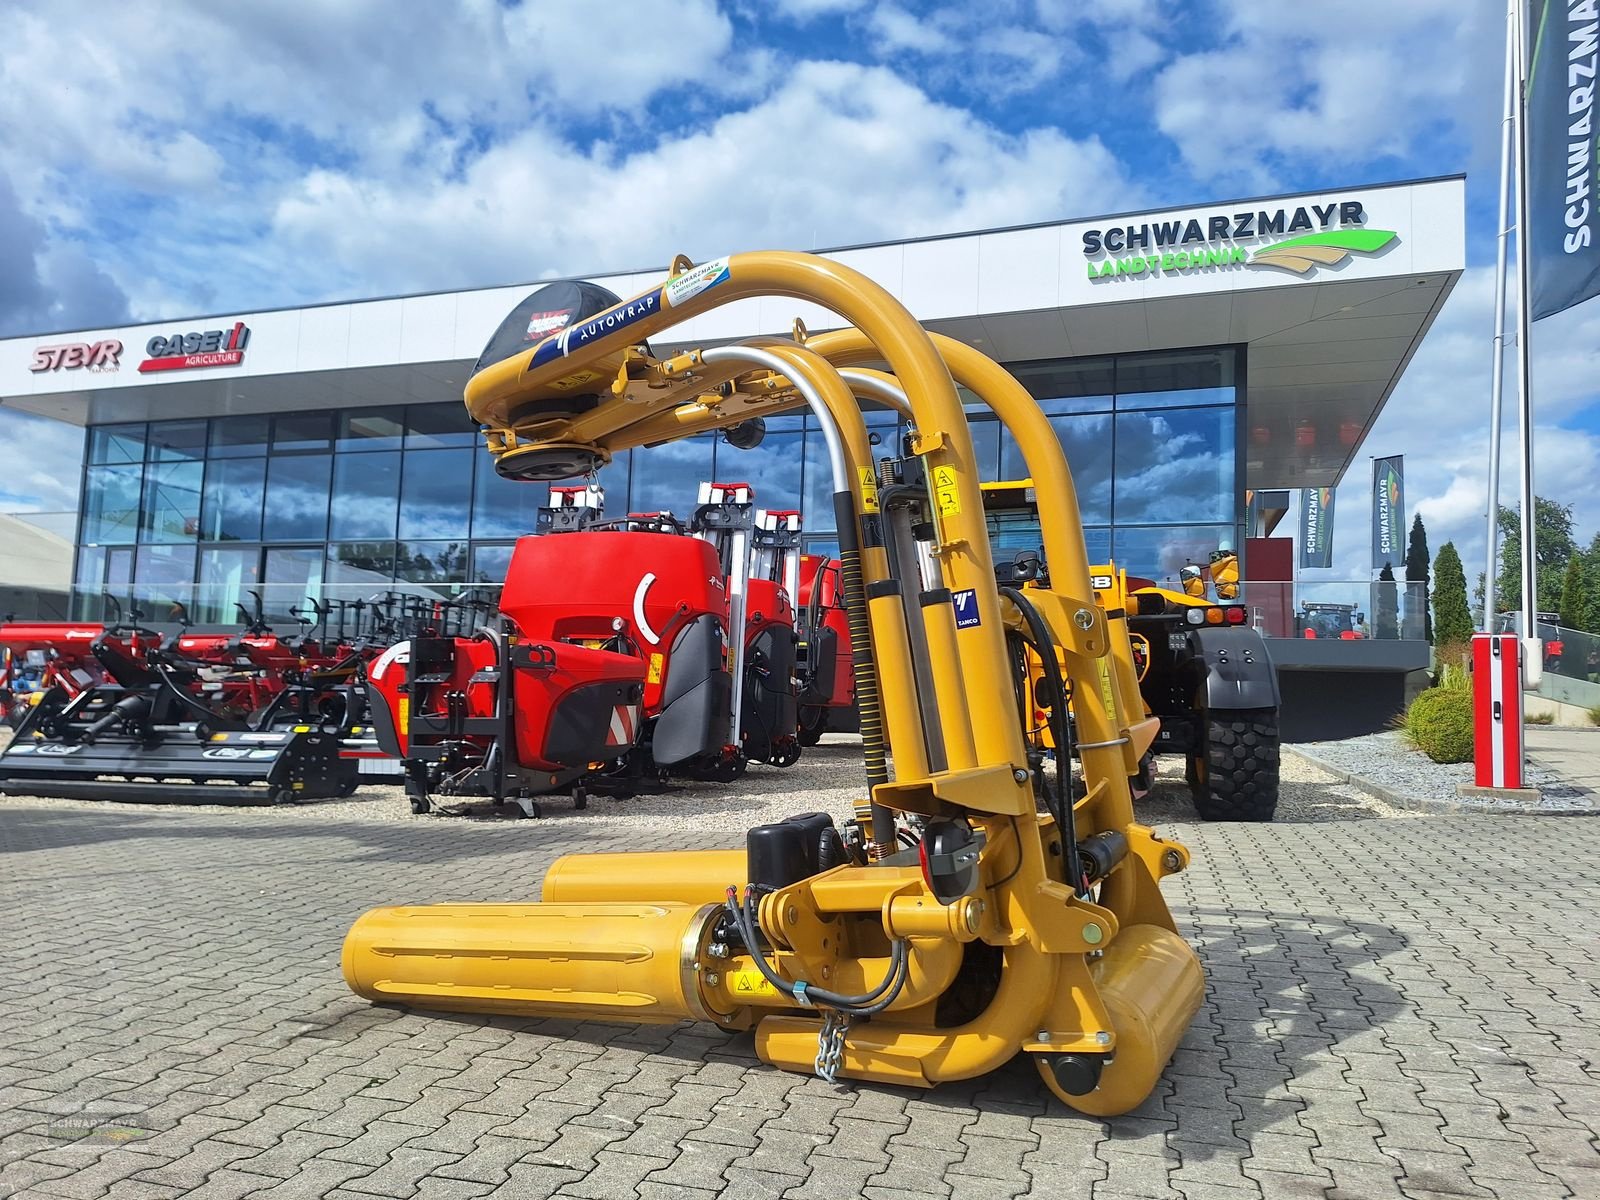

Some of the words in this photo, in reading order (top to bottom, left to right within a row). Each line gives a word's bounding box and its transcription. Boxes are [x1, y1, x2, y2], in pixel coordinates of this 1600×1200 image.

[1564, 0, 1599, 254] SCHWARZMA
[1082, 201, 1364, 254] SCHWARZMAYR
[671, 262, 720, 290] SCHWARZMAYR
[1087, 246, 1247, 279] LANDTECHNIK
[580, 296, 654, 341] AUTOWRAP
[31, 340, 123, 372] STEYR
[184, 351, 238, 367] AGRICULTURE
[1307, 488, 1318, 553] SCHWARZMAY
[1380, 479, 1390, 553] SCHWARZMAYR
[957, 617, 979, 627] TANCO
